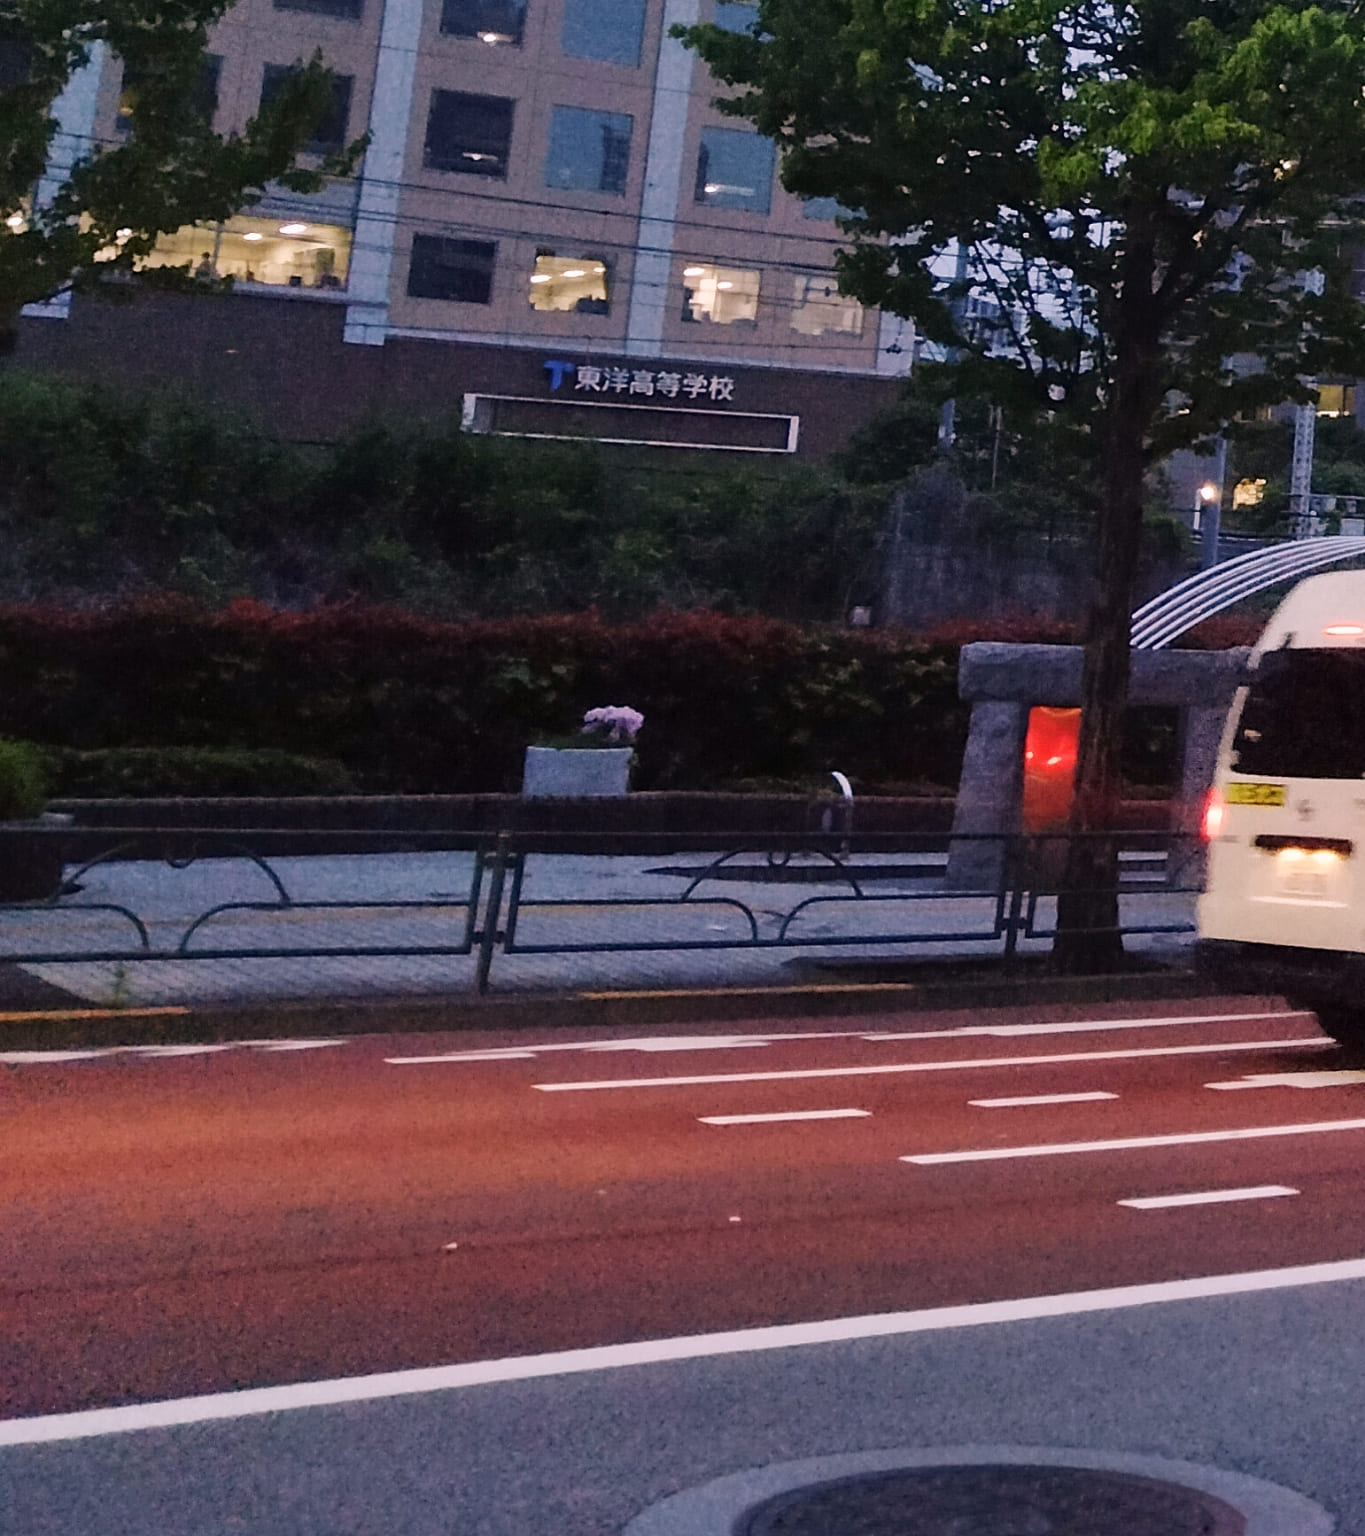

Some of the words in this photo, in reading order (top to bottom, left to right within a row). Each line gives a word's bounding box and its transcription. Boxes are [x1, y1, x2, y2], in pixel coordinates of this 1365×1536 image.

[574, 365, 736, 402] 東洋高等学校
